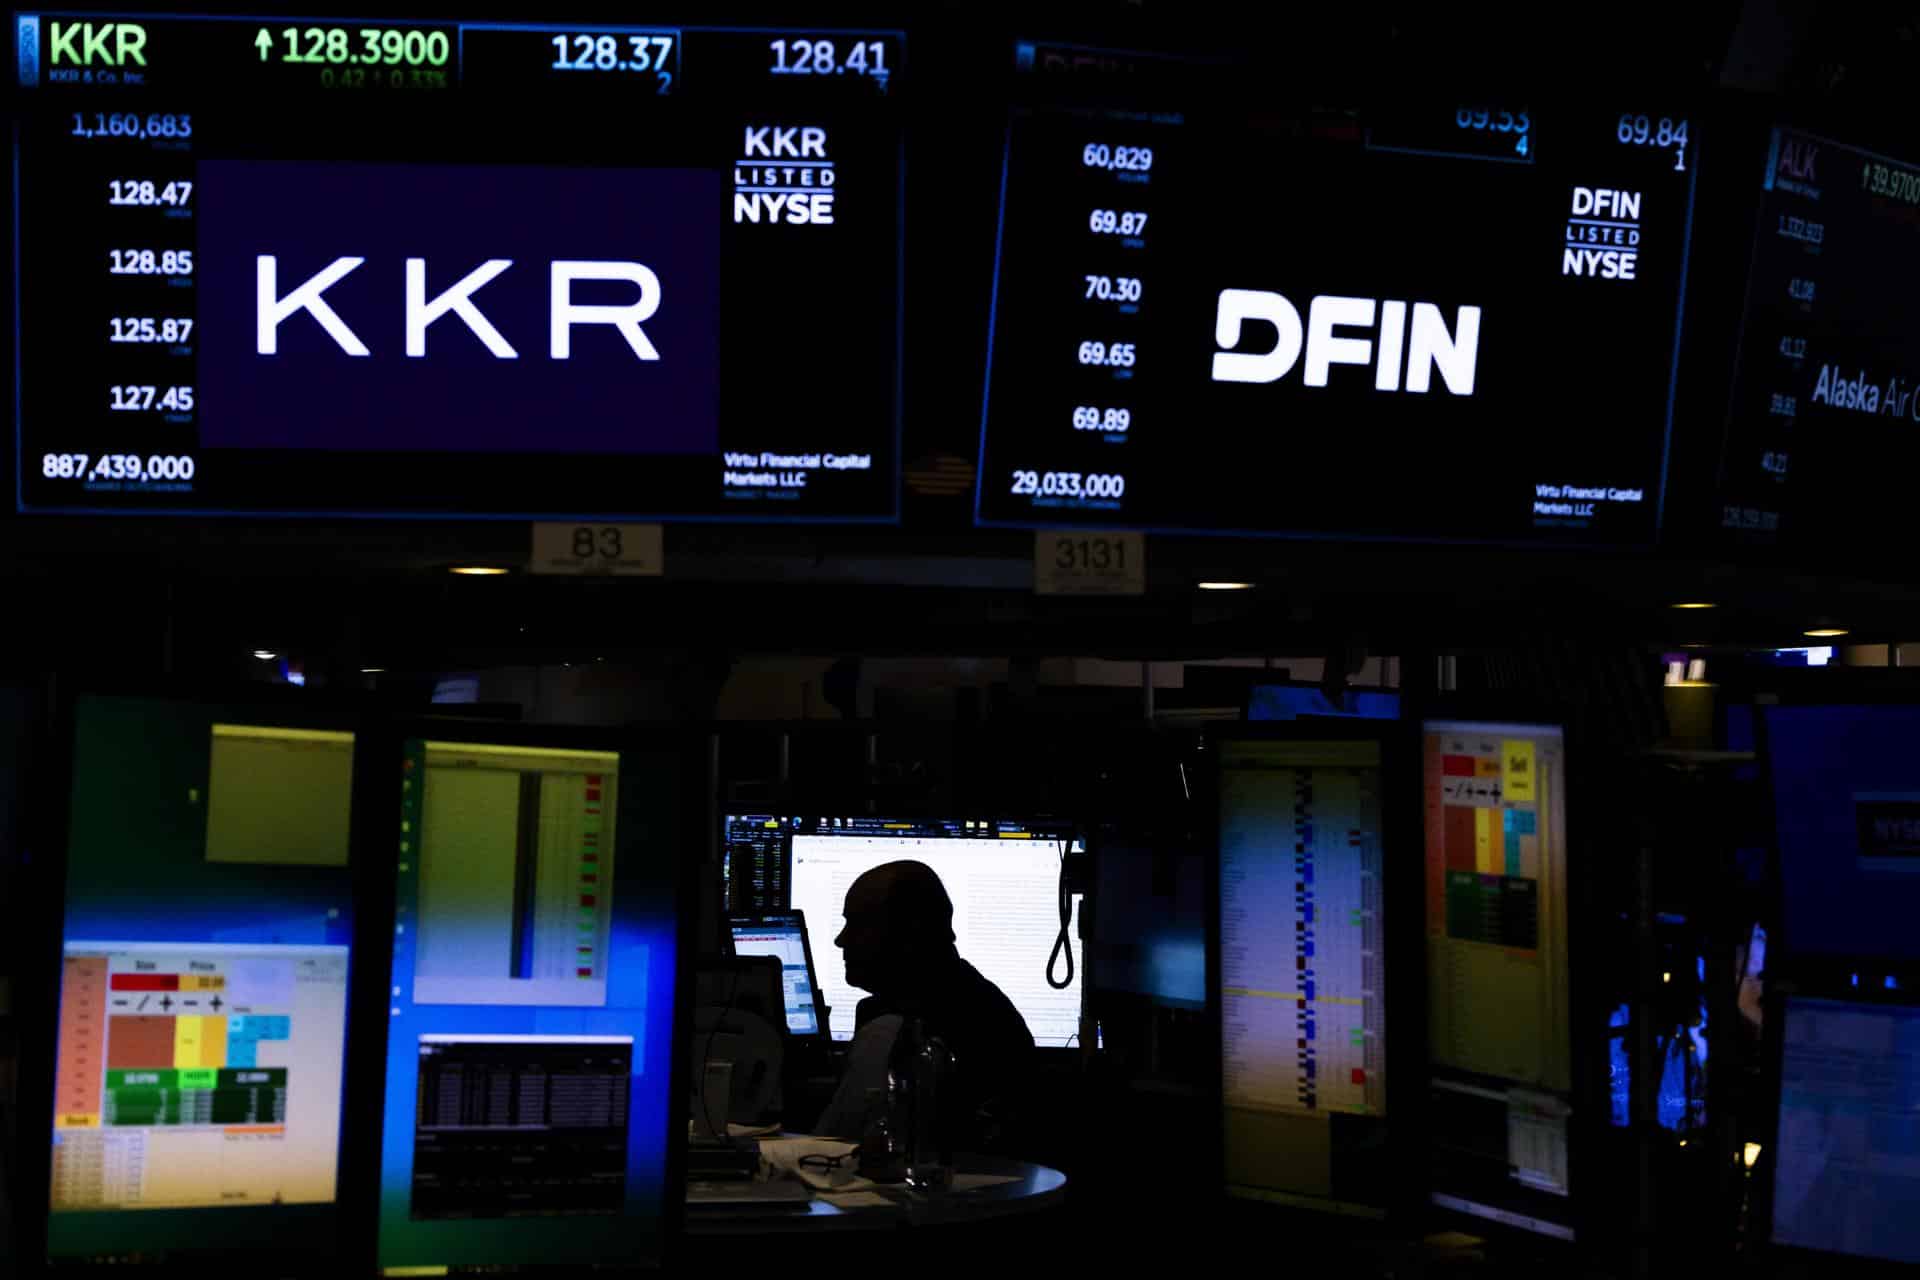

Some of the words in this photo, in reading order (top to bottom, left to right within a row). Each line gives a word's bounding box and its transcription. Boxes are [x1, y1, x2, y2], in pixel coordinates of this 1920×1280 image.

[49, 22, 148, 66] KKR
[281, 27, 449, 65] 128.3900
[550, 34, 673, 71] 128.37
[768, 39, 890, 76] 128.41
[655, 73, 672, 95] 2
[71, 111, 193, 140] 1,160,683
[1616, 113, 1689, 148] 69.84
[743, 125, 828, 158] KKR
[1082, 143, 1153, 172] 60,829
[1672, 150, 1686, 172] 1
[733, 167, 836, 186] LISTED
[108, 179, 193, 207] 128.47
[1571, 185, 1642, 221] DFIN
[733, 193, 835, 224] NYSE
[1088, 208, 1149, 237] 69.87
[1566, 224, 1640, 246] LISTED
[109, 249, 194, 276] 128.85
[1561, 247, 1639, 280] NYSE
[1084, 273, 1143, 302] 70.30
[256, 253, 662, 362] KKR
[109, 317, 194, 344] 125.87
[1210, 287, 1483, 397] DFIN
[1077, 340, 1137, 368] 69.65
[110, 385, 195, 412] 127.45
[1810, 361, 1880, 414] Alaska
[1880, 377, 1912, 418] Air
[1071, 405, 1132, 433] 69.89
[42, 453, 196, 482] 887,439,000
[760, 452, 821, 470] Financial
[823, 453, 872, 472] Capital
[779, 472, 808, 488] LLC
[1010, 469, 1126, 500] 29,033,000
[573, 527, 622, 559] 83
[1055, 538, 1125, 569] 3131
